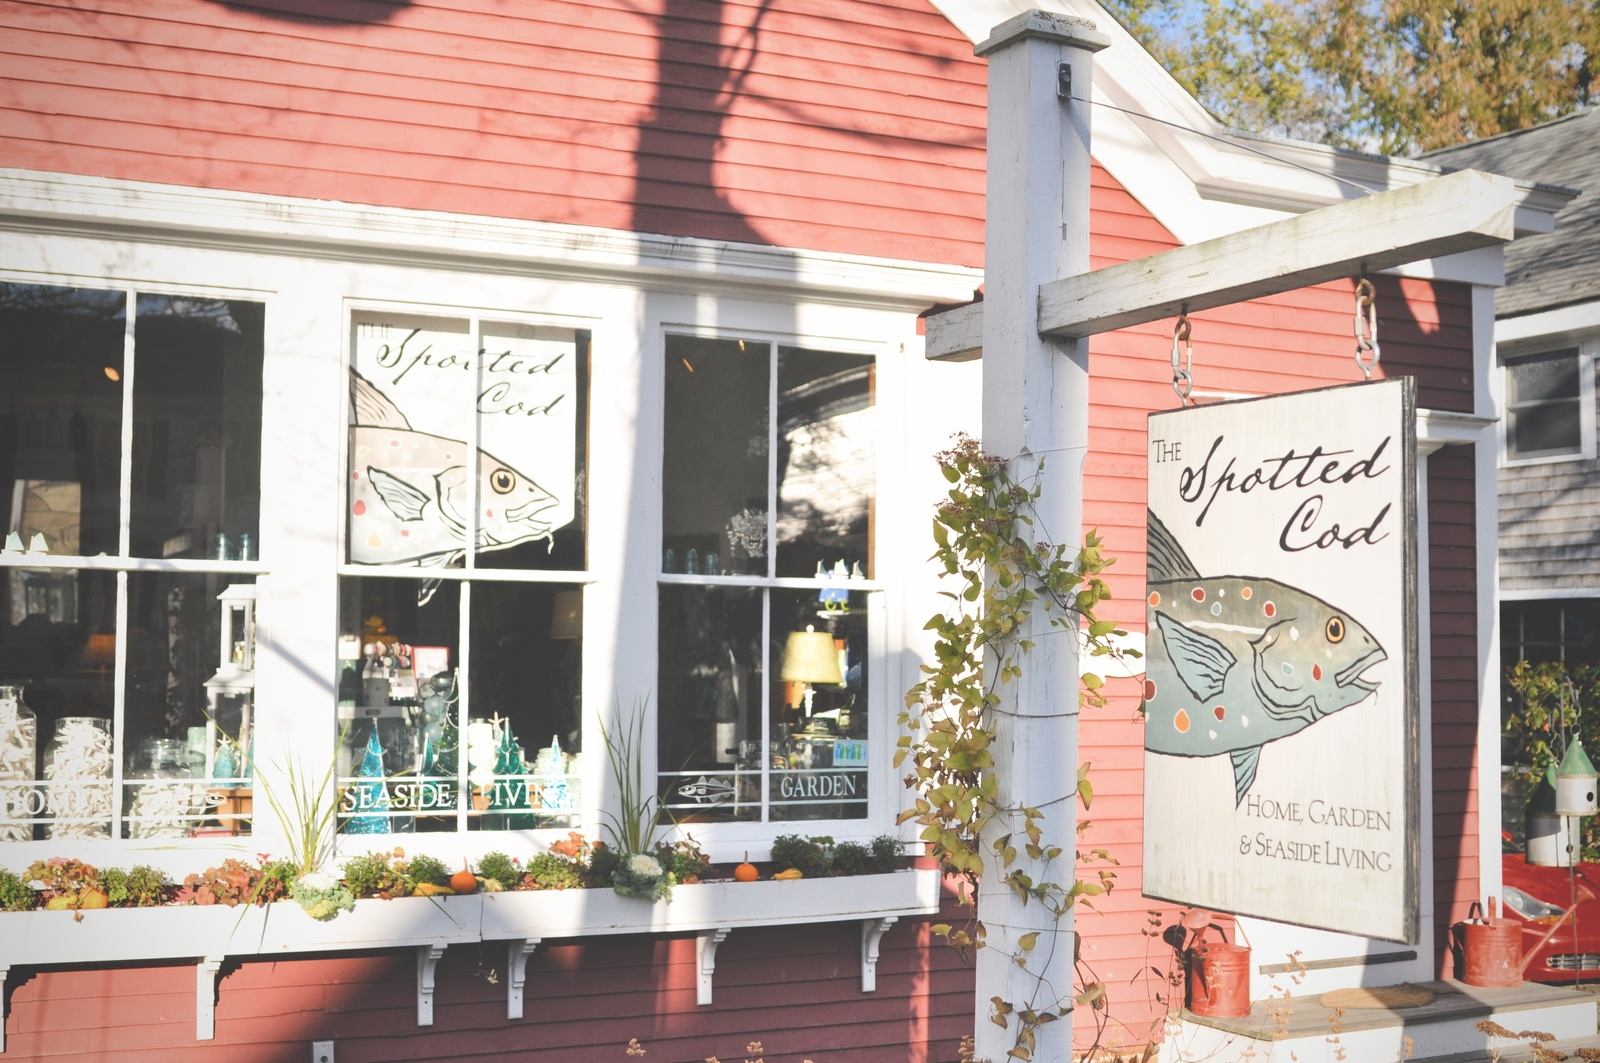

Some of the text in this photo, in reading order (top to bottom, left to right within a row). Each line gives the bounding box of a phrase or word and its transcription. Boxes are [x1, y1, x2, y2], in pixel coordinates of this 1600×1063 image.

[476, 382, 566, 417] Cod
[1152, 434, 1392, 527] THE Spotted
[1279, 494, 1392, 552] Cod
[344, 782, 452, 812] SEASIDE
[480, 781, 572, 809] LIVIN
[780, 774, 857, 799] GARDEN
[1246, 793, 1391, 831] HOME, GARDEN
[1239, 832, 1393, 872] & SEASIDE LIVING
